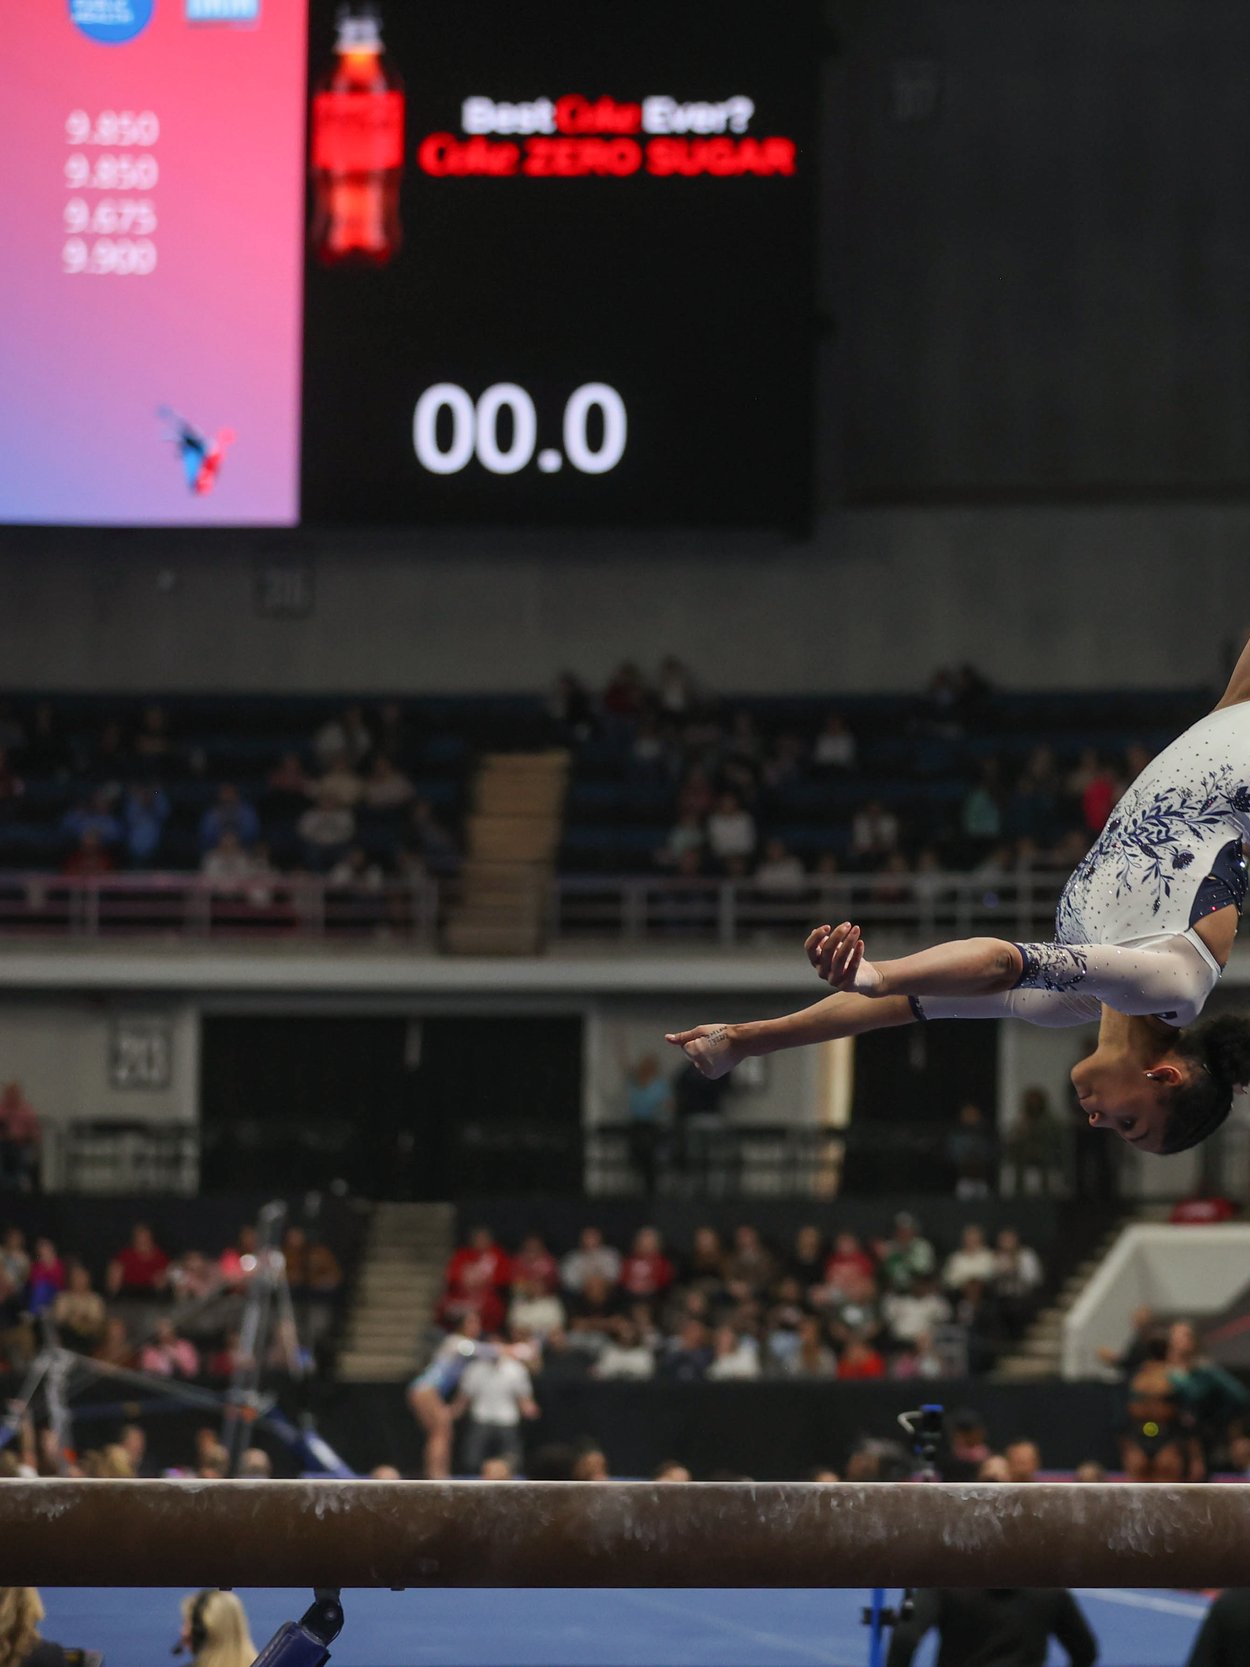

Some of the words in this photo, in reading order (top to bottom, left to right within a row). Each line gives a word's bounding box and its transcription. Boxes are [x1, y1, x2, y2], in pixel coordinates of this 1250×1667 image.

[65, 110, 159, 146] 9.850
[463, 97, 556, 133] Best
[642, 96, 754, 134] Ever?
[64, 153, 158, 190] 9.850
[523, 138, 642, 176] ZERO
[645, 137, 797, 175] SUGAR
[413, 382, 627, 475] 00.0
